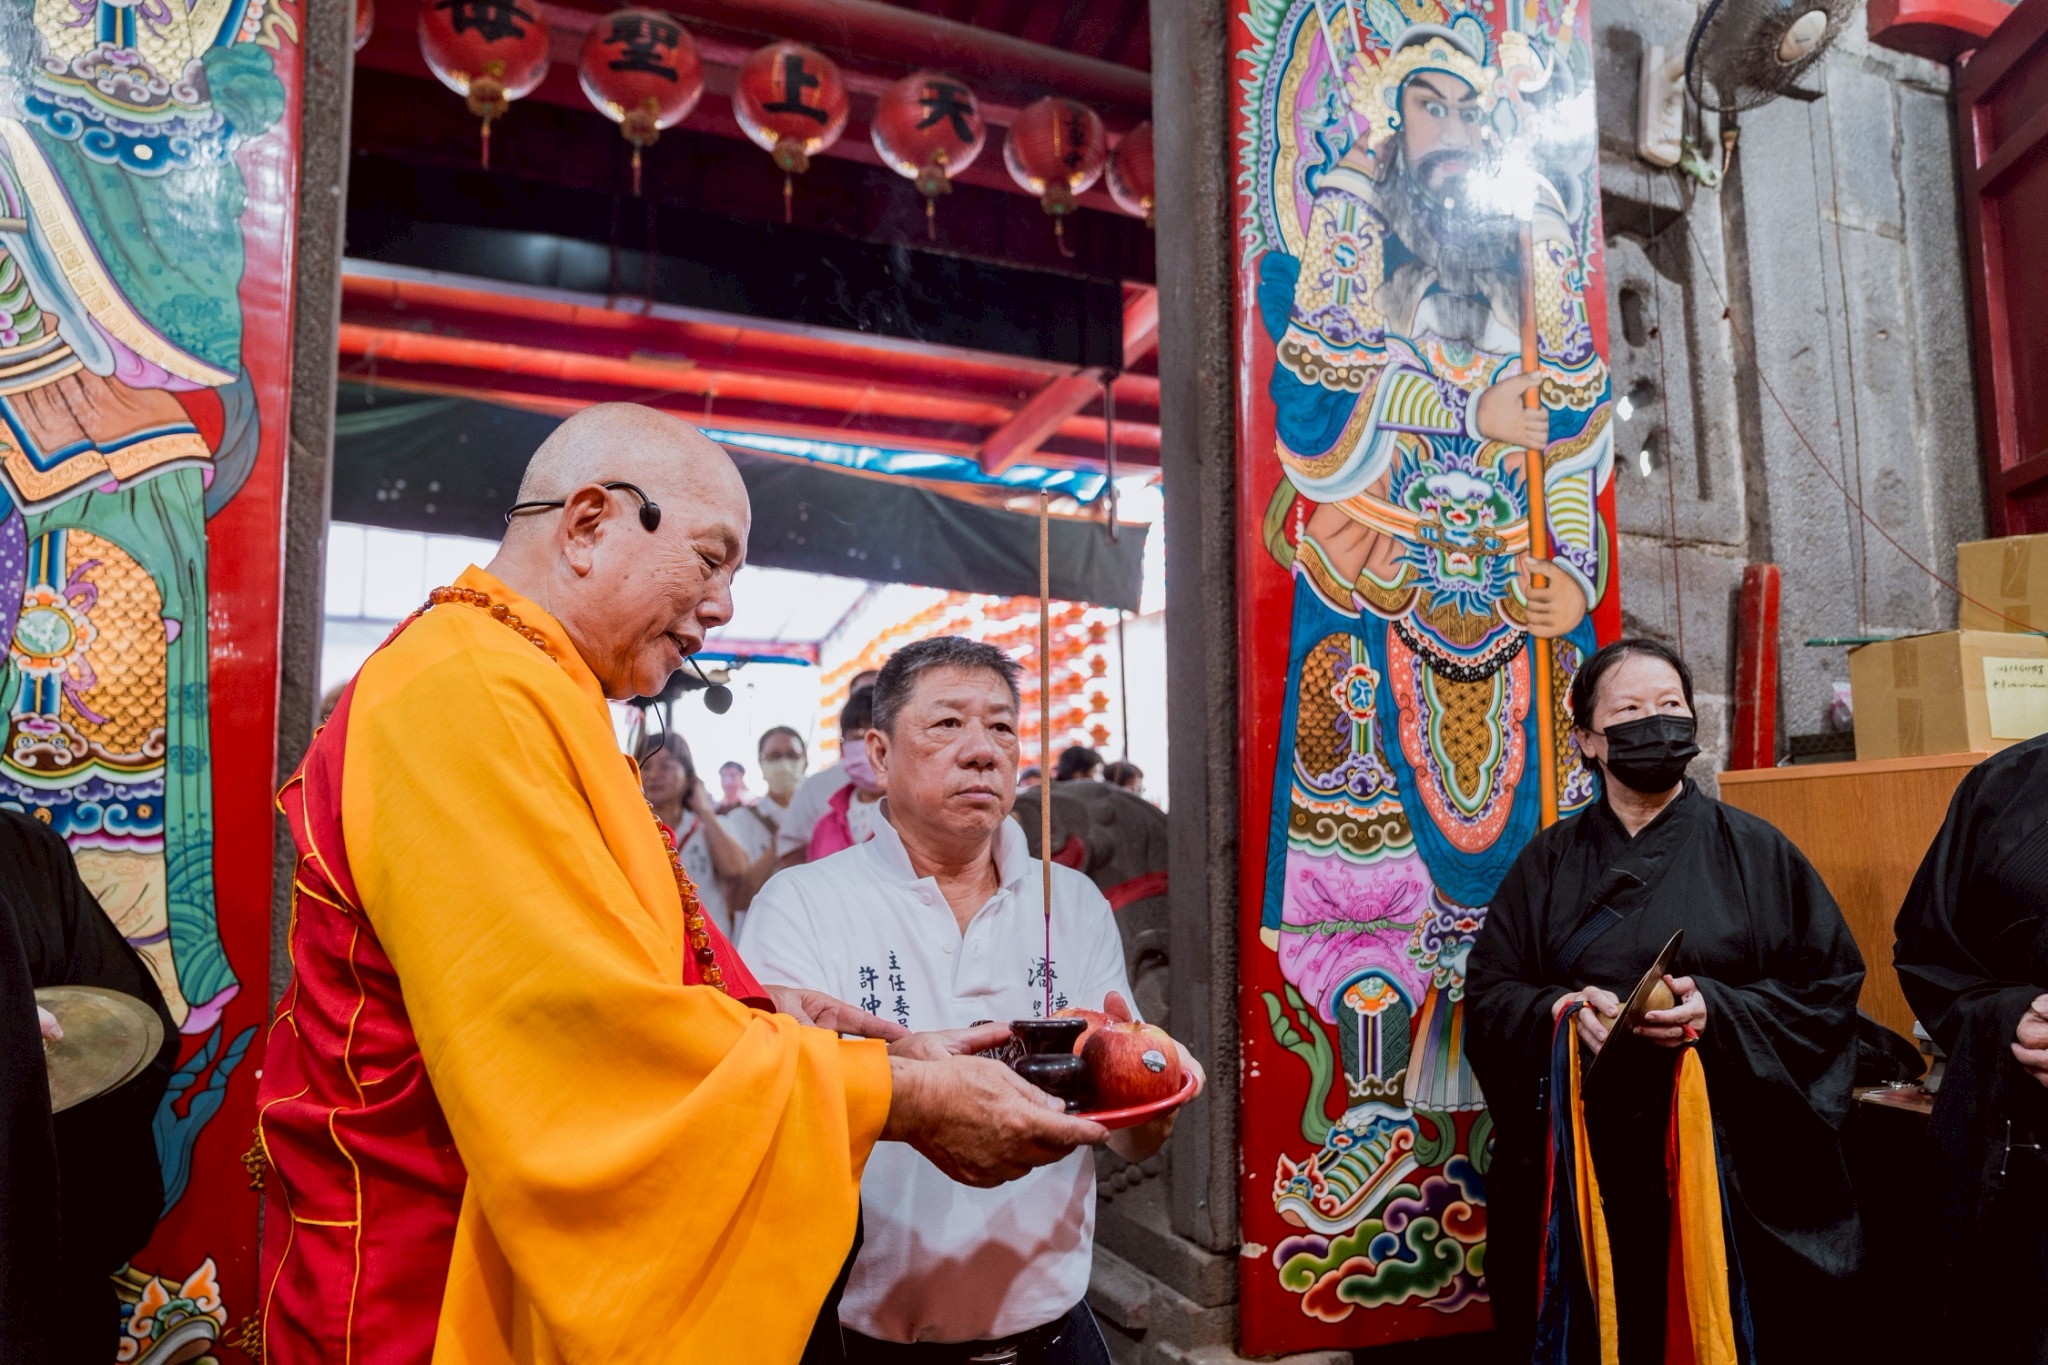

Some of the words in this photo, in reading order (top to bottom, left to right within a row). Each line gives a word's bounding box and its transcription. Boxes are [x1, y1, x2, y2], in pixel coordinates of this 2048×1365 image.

[604, 15, 679, 82] 聖
[763, 54, 829, 125] 上
[915, 81, 975, 144] 天
